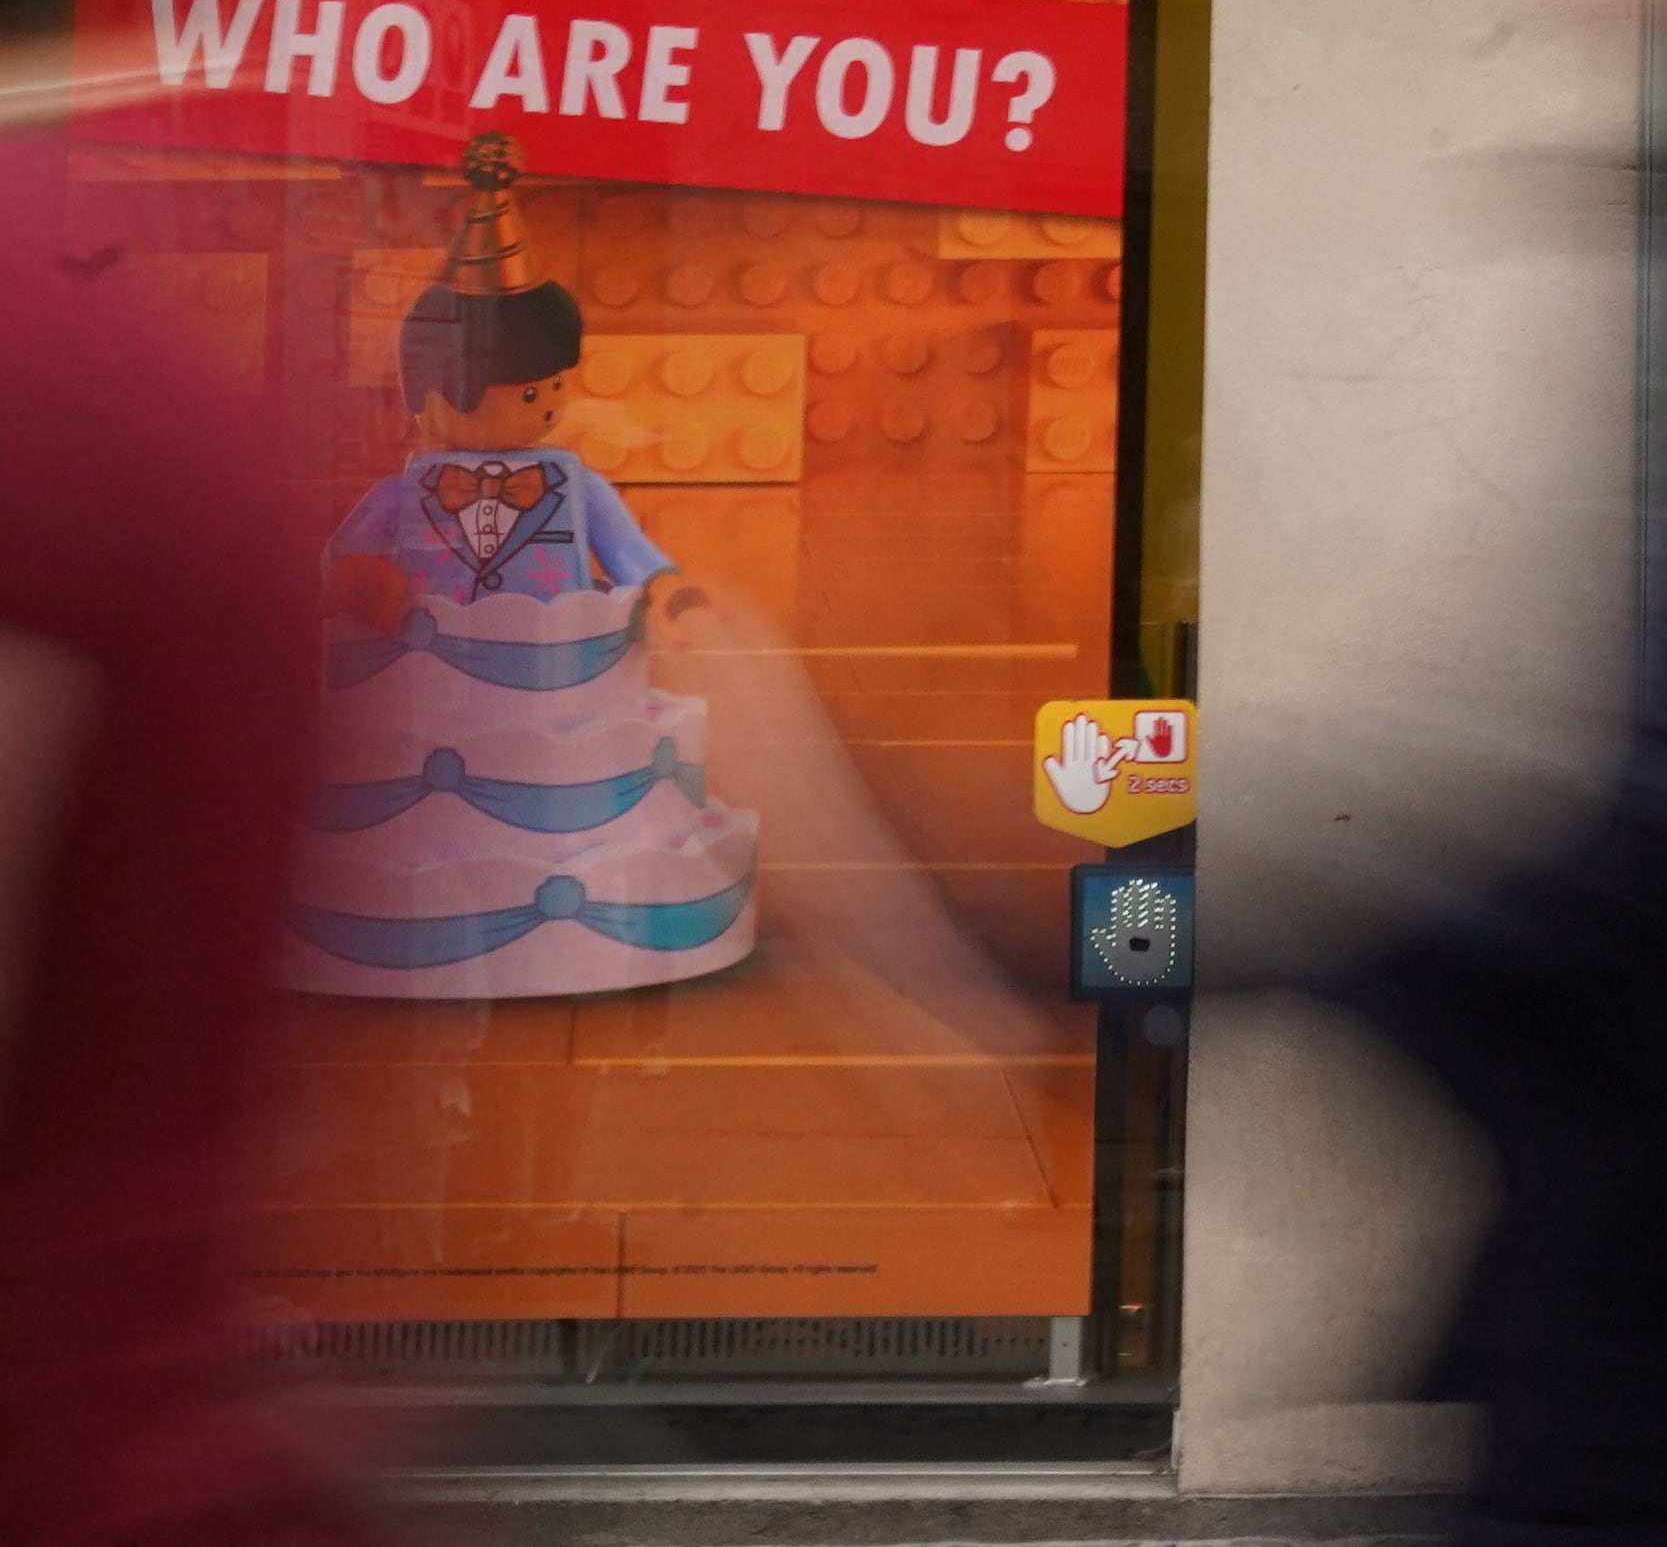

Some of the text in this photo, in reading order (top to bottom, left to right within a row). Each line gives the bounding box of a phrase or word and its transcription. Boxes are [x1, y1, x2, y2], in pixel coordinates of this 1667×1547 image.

[470, 14, 700, 125] ARE
[744, 32, 1058, 153] YOU?
[1127, 775, 1141, 794] 2
